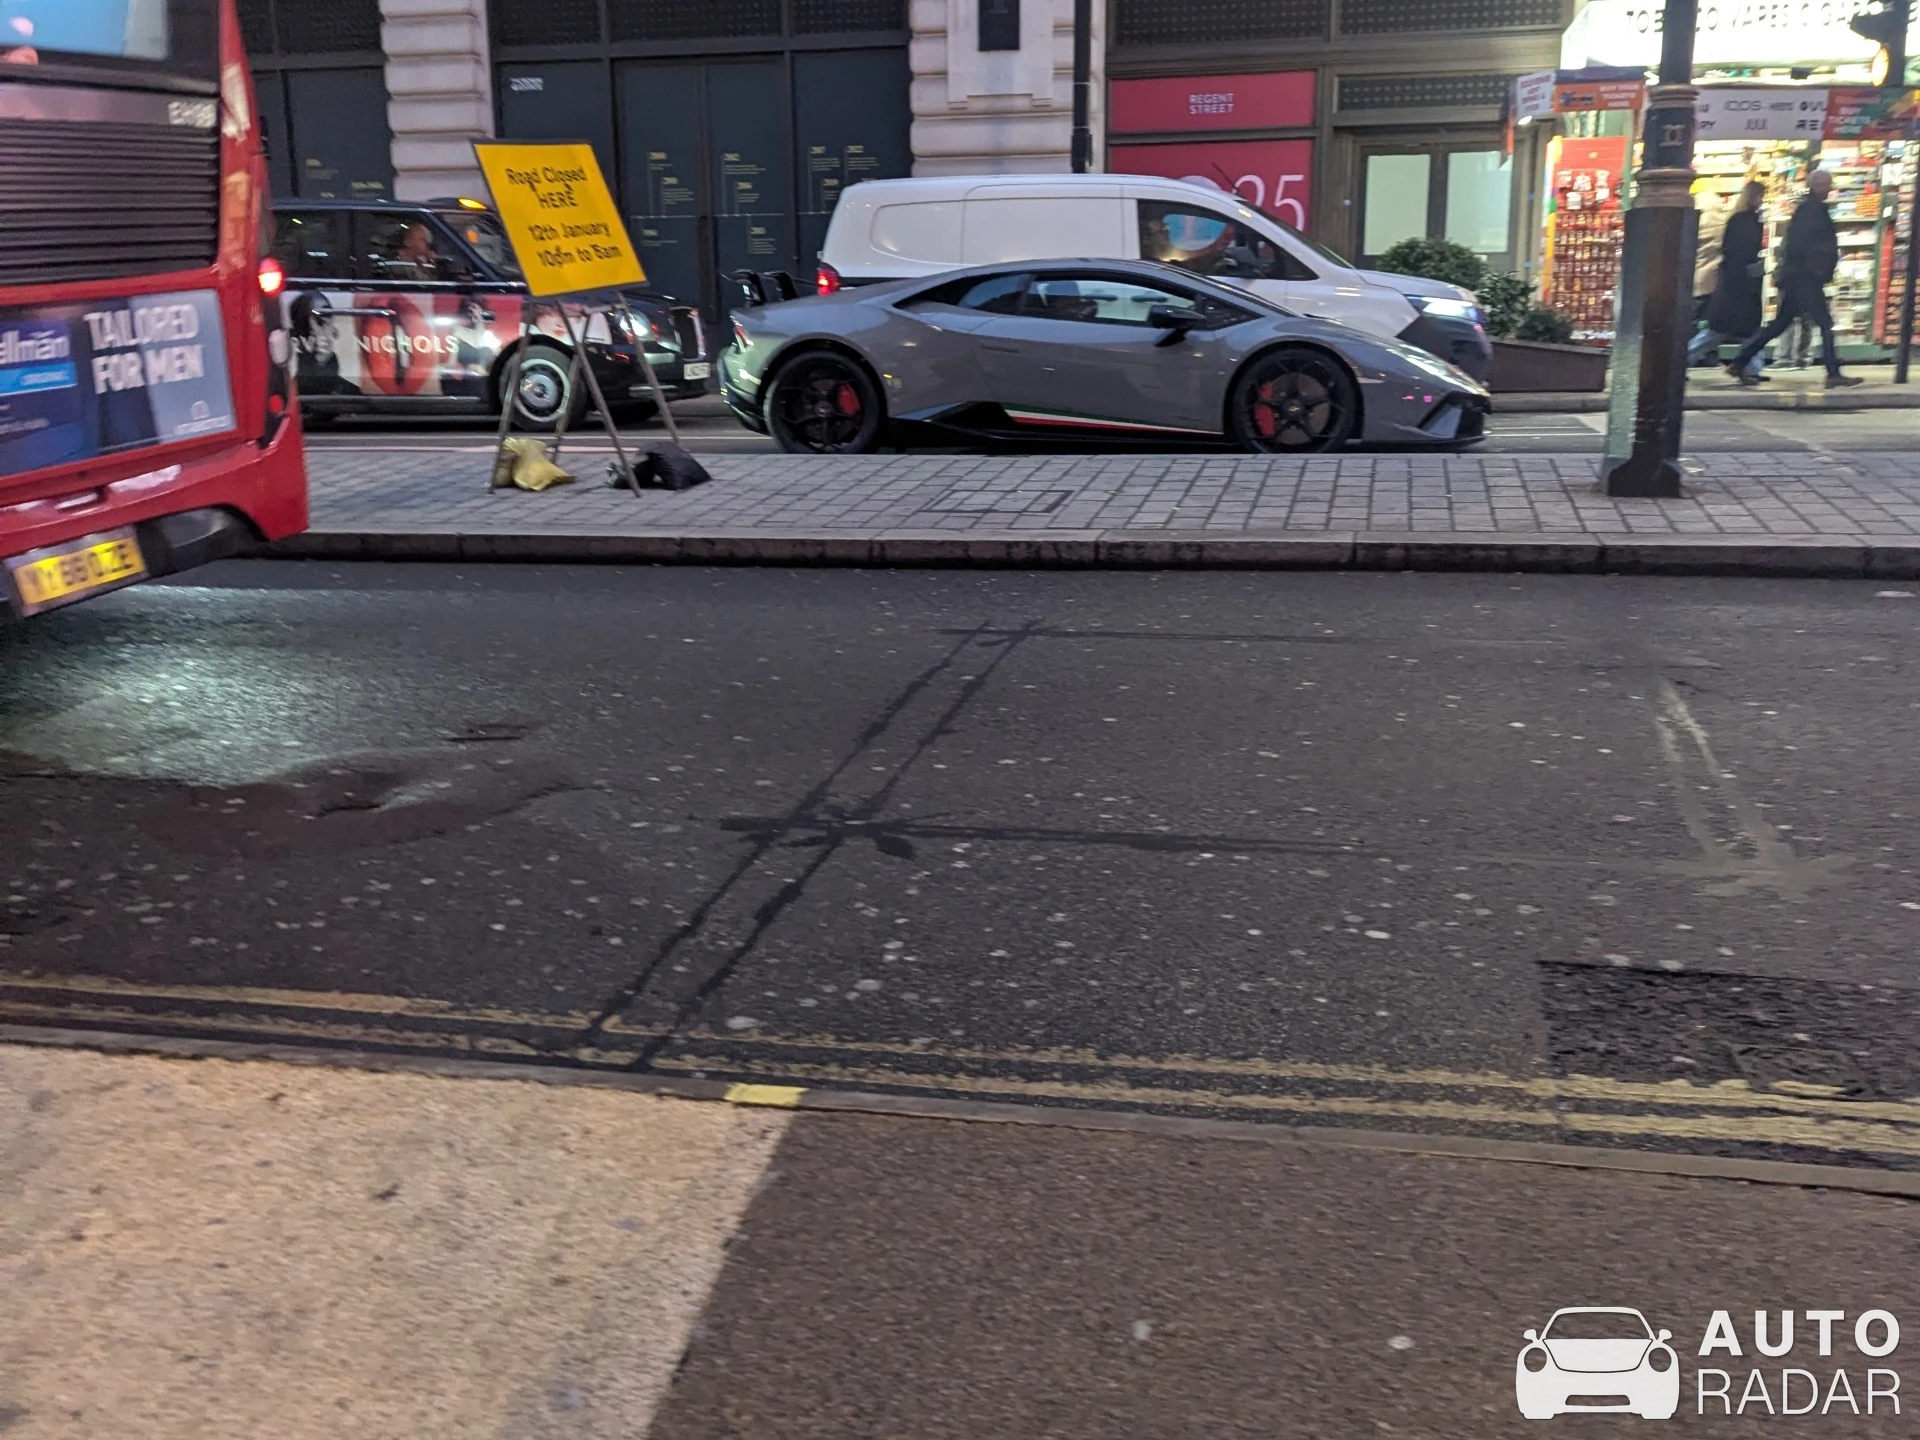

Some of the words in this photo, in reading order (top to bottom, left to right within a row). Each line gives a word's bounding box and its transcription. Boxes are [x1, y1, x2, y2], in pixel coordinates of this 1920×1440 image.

[1731, 4, 1790, 28] VAPES
[1189, 93, 1235, 105] REGENT
[1189, 103, 1235, 115] STREET
[504, 168, 542, 185] Road
[541, 166, 588, 184] Closed
[534, 190, 579, 209] HERE
[560, 222, 612, 239] January
[576, 247, 593, 263] to
[83, 303, 200, 351] TAILORED
[354, 333, 460, 354] NICHOLS
[91, 350, 147, 395] FOR
[145, 344, 206, 387] MEN
